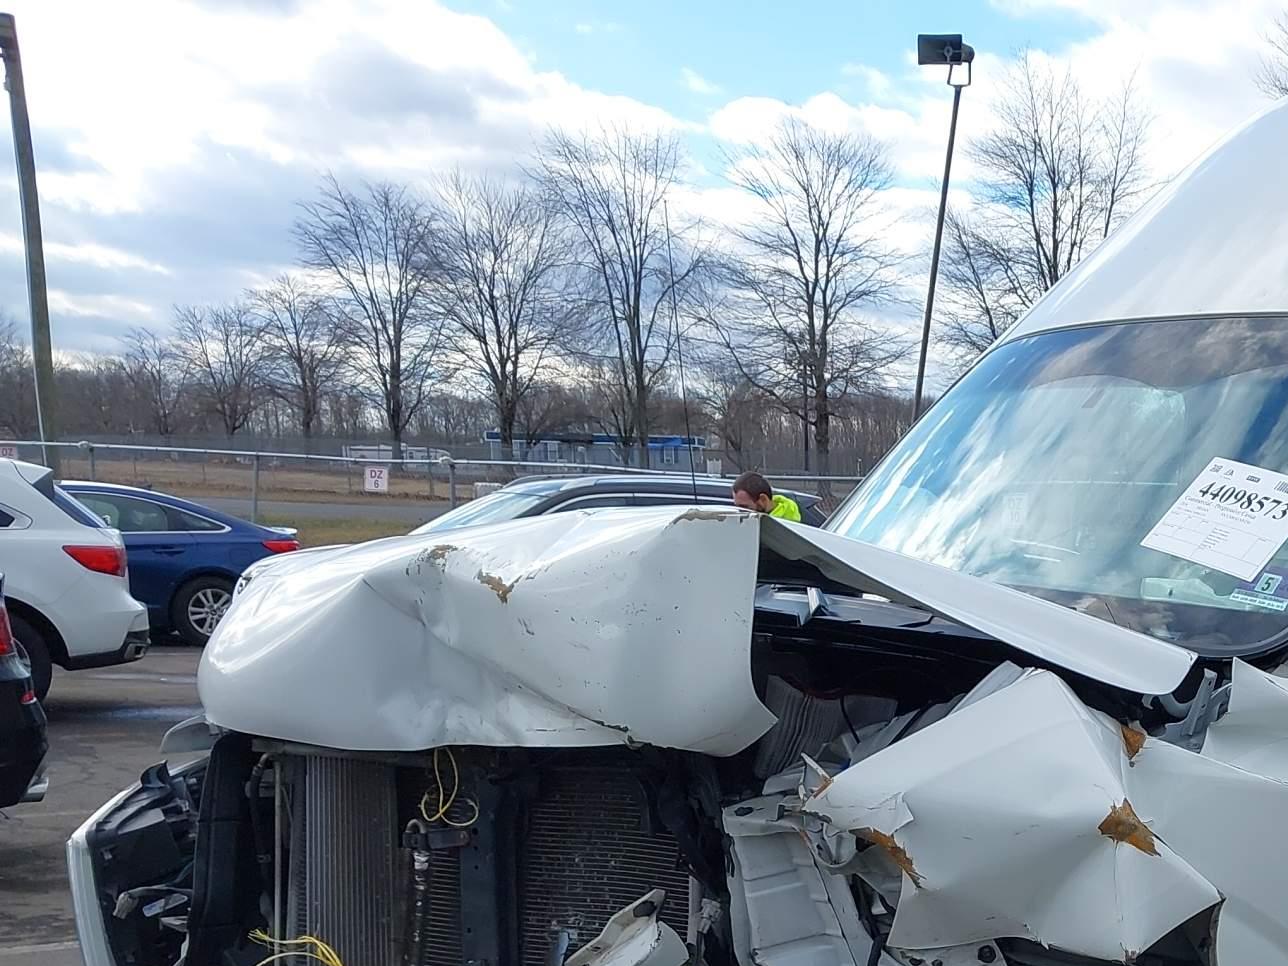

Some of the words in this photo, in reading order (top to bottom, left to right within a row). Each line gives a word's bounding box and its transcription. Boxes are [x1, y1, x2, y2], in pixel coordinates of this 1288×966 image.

[370, 470, 384, 479] DZ
[374, 480, 380, 488] 6
[1261, 577, 1275, 591] 5
